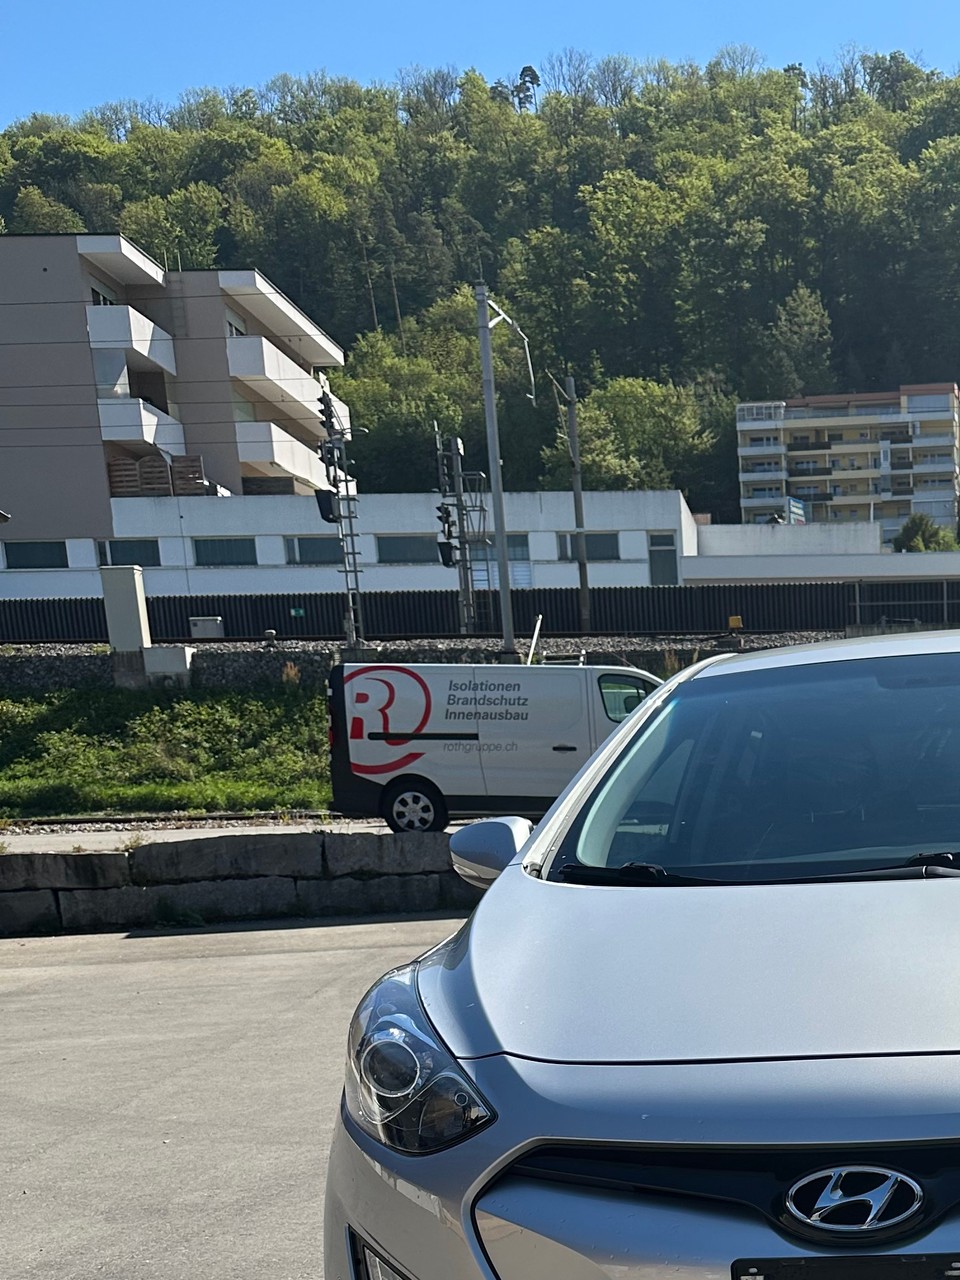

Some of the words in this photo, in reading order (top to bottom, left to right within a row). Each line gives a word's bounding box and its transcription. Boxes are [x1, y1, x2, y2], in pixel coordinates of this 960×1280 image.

[448, 680, 521, 692] Isolationen
[446, 694, 529, 706] Brandschutz
[444, 708, 529, 720] Innenausbau
[443, 741, 518, 753] rothgruppe.ch
